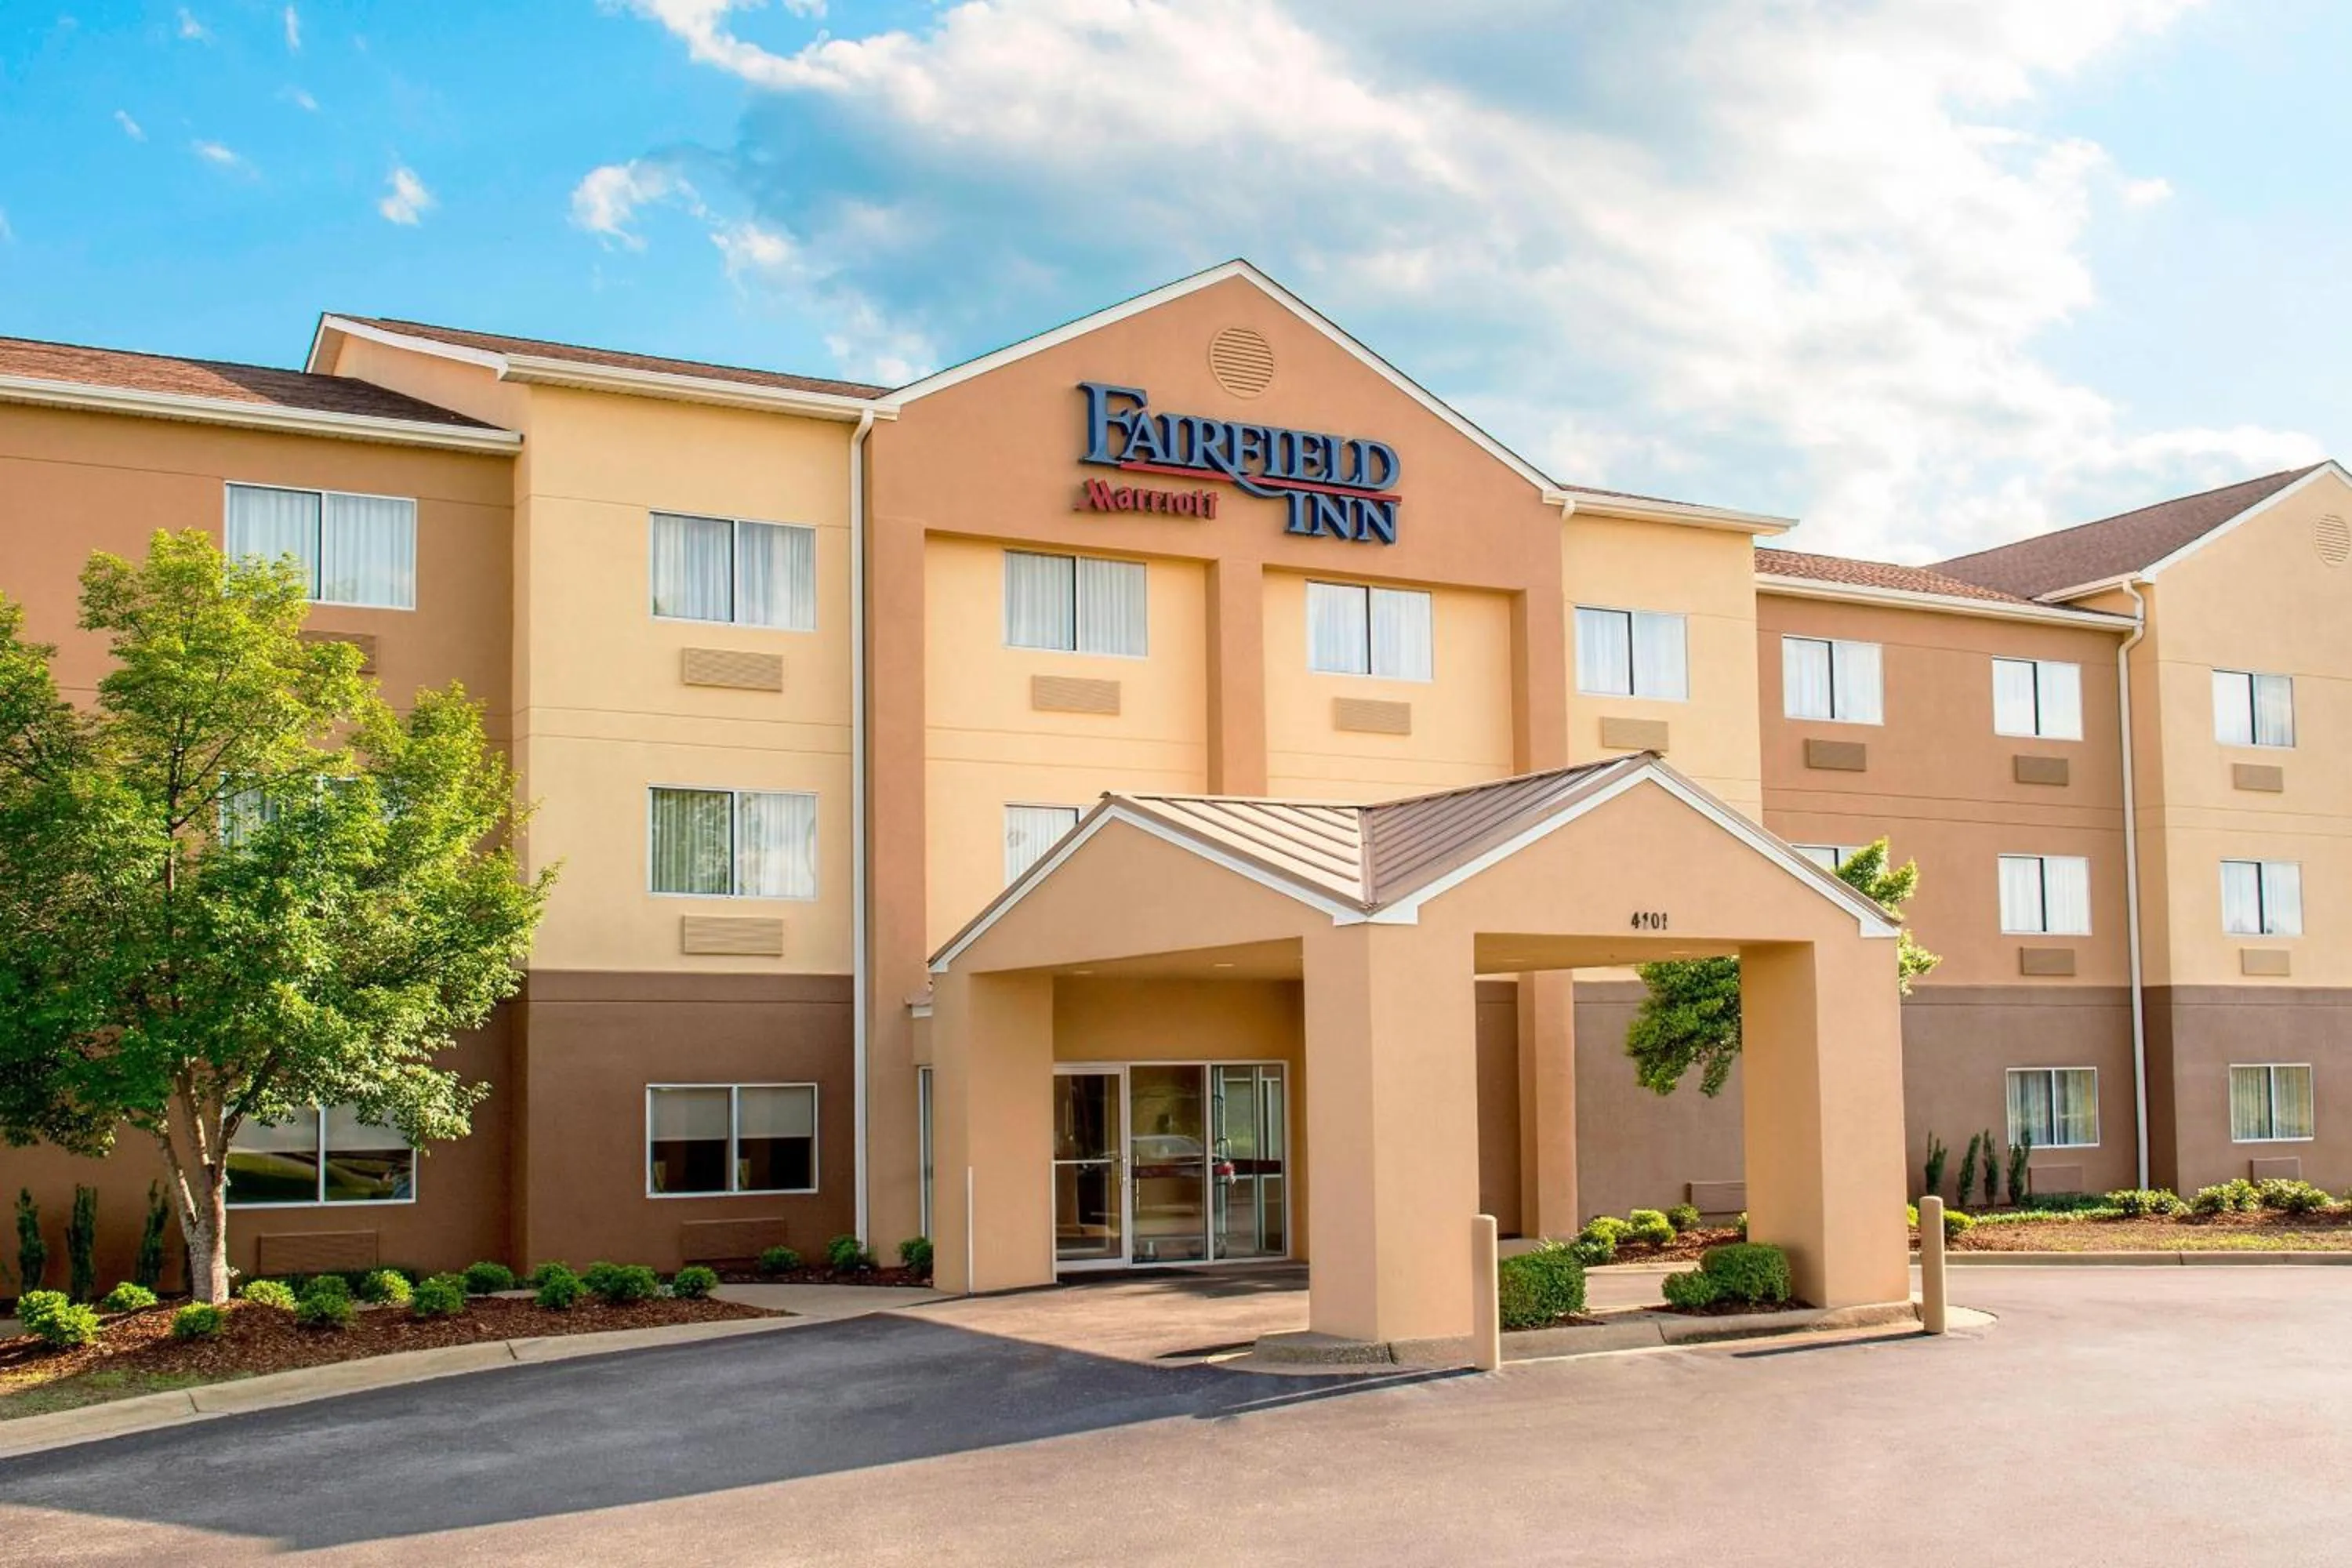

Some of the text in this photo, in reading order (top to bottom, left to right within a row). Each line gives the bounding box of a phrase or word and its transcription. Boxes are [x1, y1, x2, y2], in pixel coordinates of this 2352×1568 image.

[1077, 382, 1401, 497] FAIRFIELD
[1073, 477, 1220, 520] Marriott
[1284, 490, 1397, 544] INN
[1631, 912, 1668, 930] 4101
